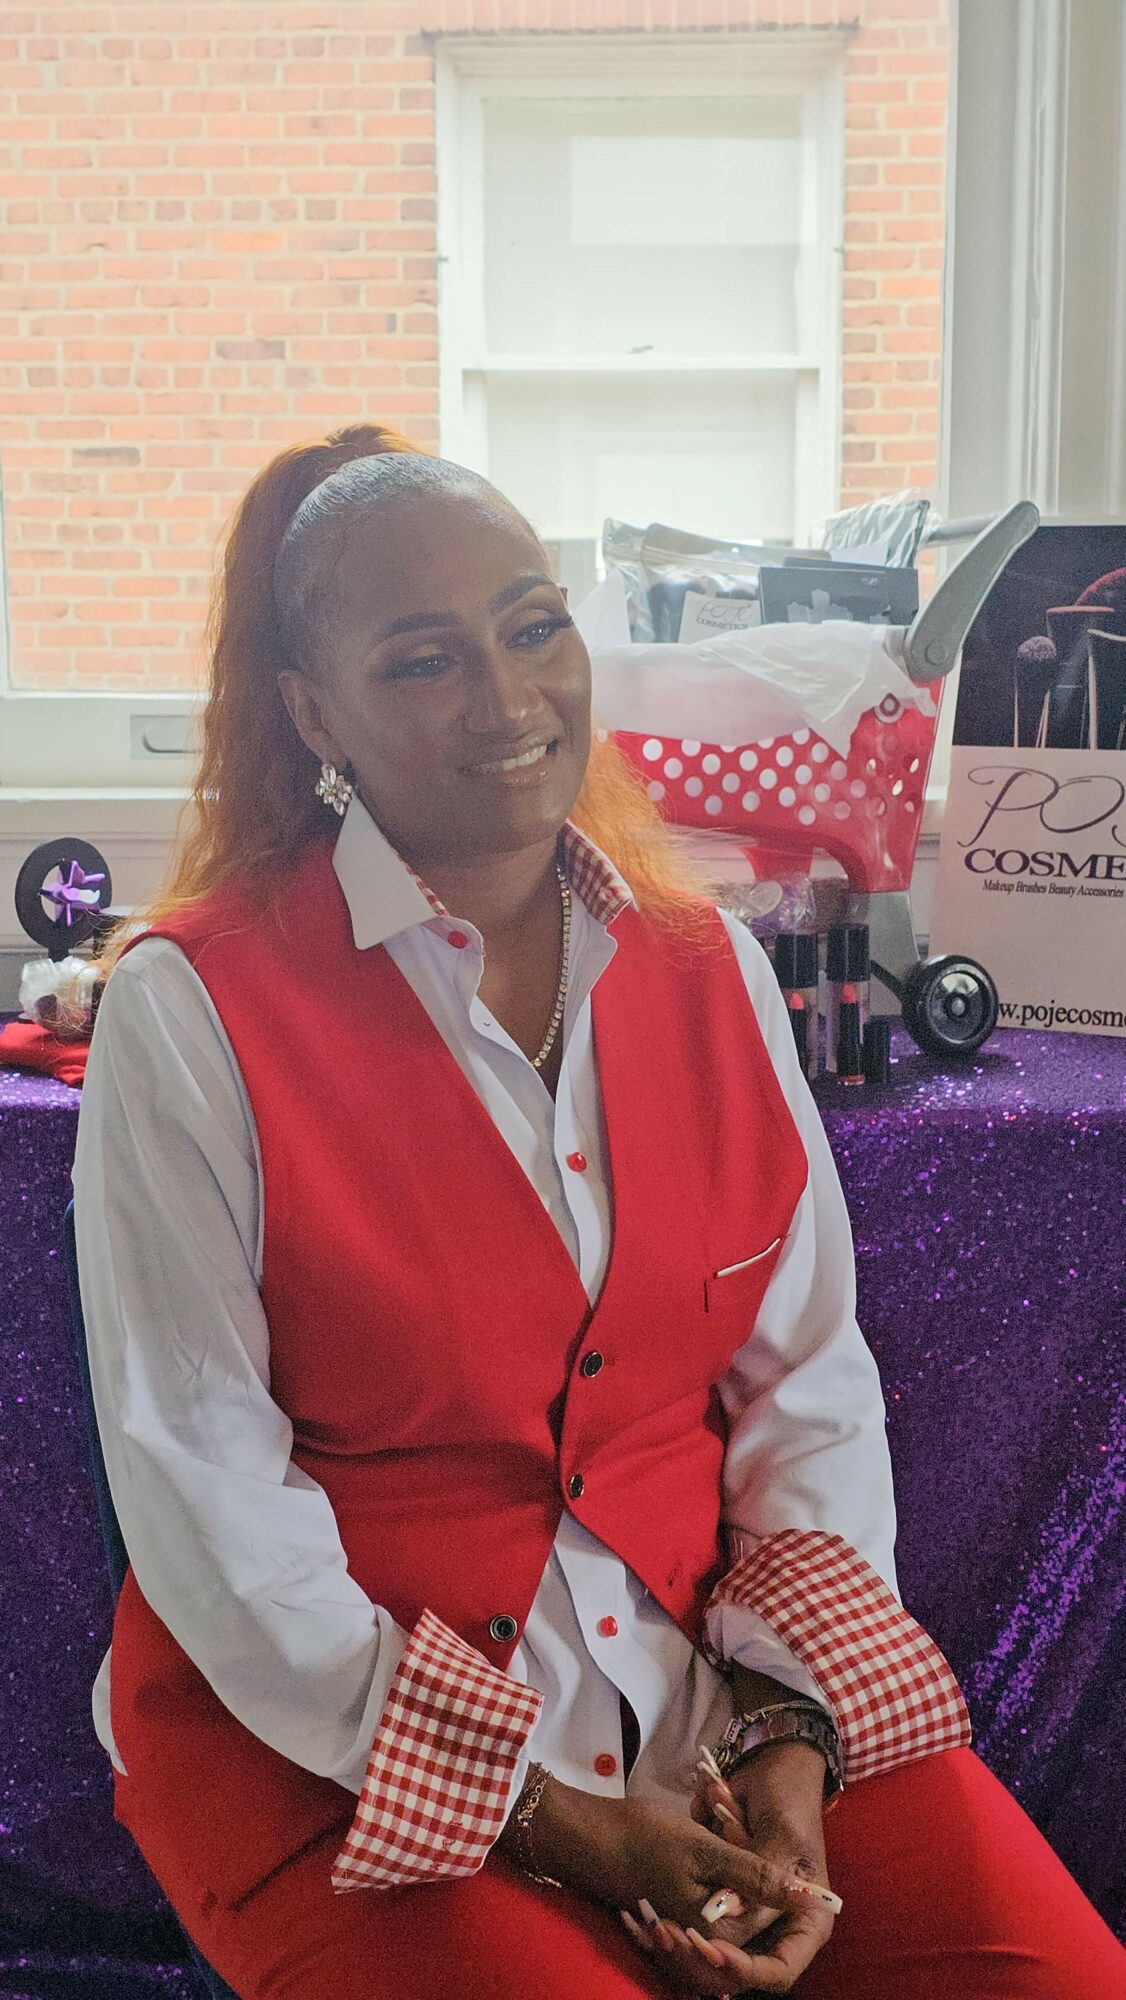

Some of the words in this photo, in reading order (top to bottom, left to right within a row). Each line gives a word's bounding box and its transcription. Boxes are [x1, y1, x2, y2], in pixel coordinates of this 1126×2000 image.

[957, 765, 1126, 847] PO
[982, 879, 1014, 895] Makeup
[1016, 881, 1047, 894] Brushes
[1048, 883, 1076, 897] Beauty
[1077, 885, 1124, 898] Accessories
[999, 1000, 1126, 1027] w.pojecosm
